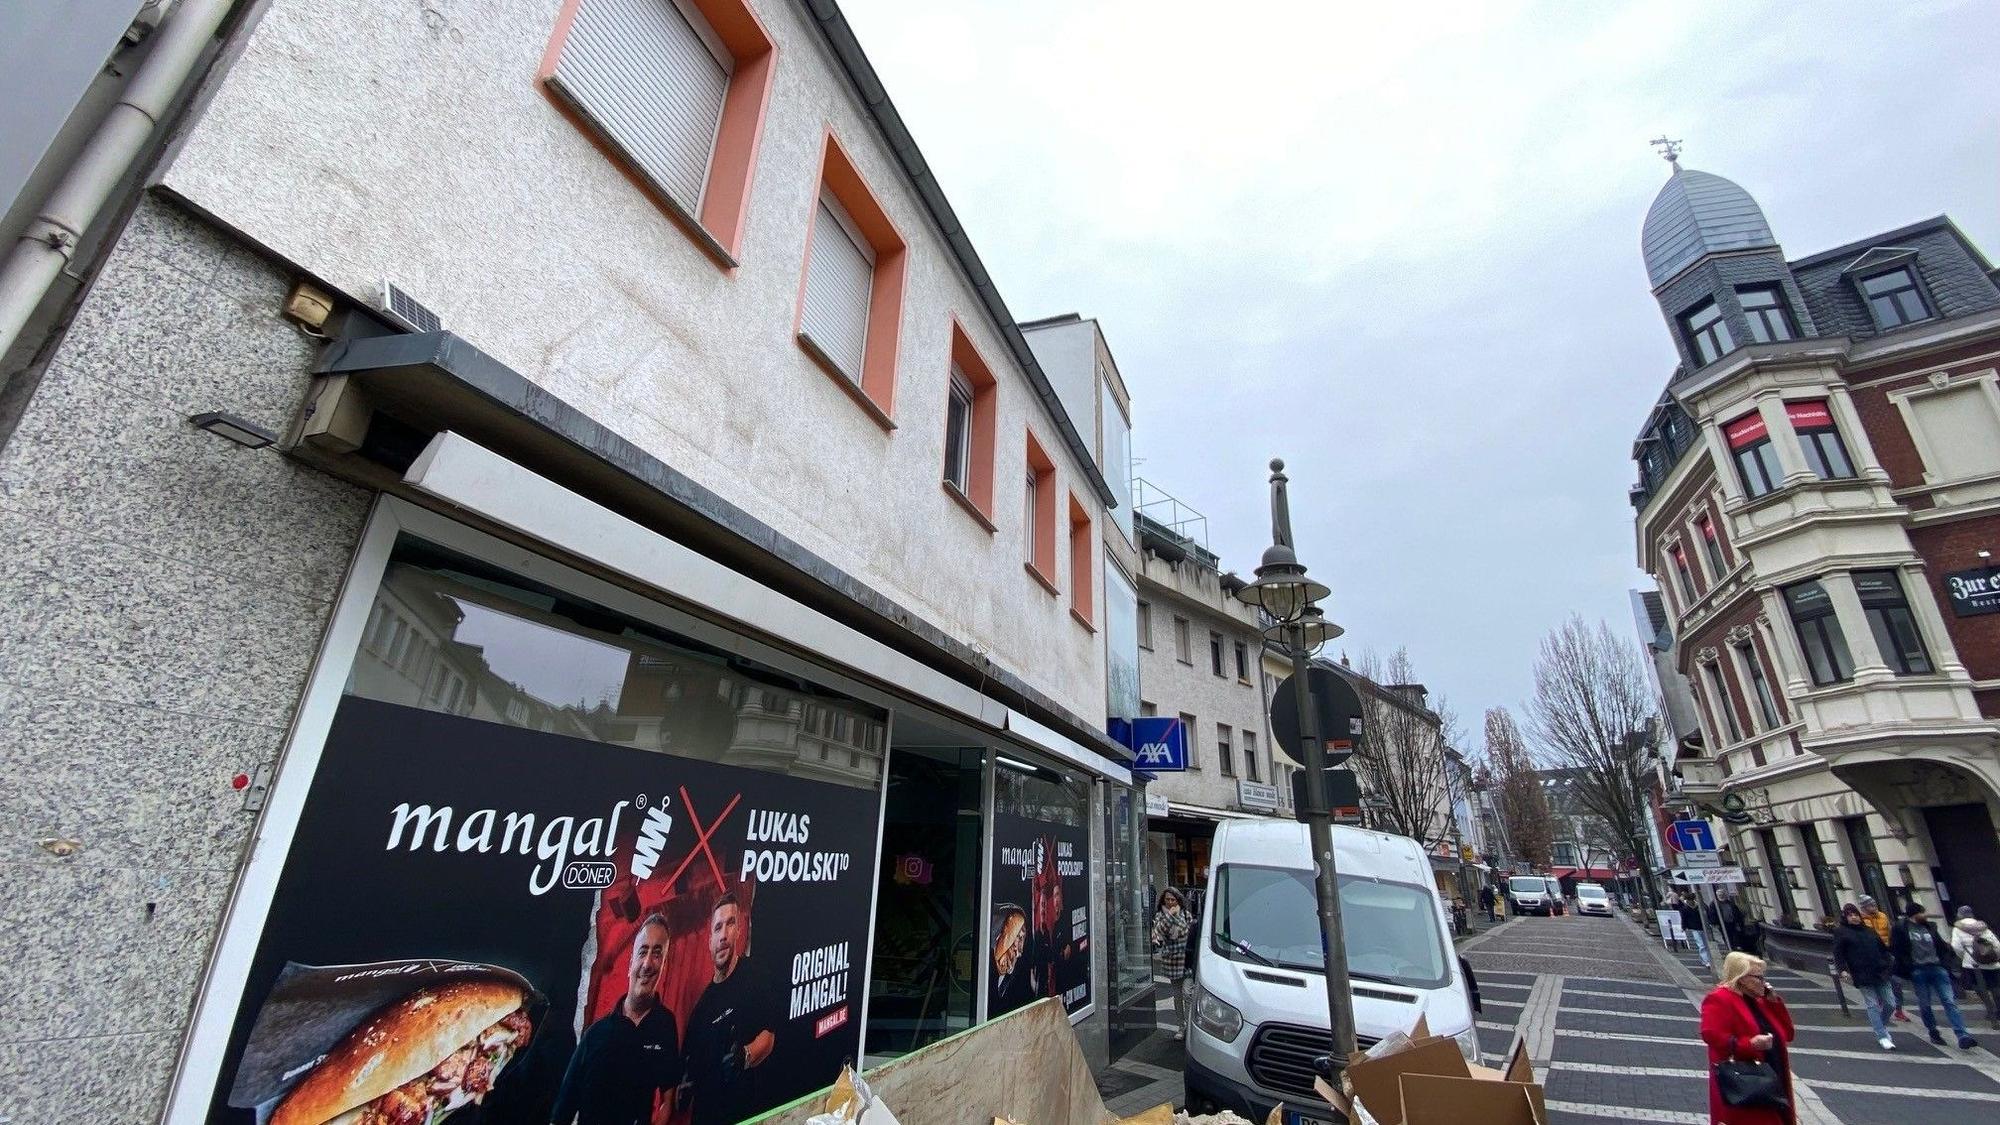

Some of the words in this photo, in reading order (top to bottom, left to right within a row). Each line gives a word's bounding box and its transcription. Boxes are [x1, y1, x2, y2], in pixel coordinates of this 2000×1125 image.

[1950, 577, 1986, 600] Zur
[1134, 742, 1174, 763] AXA
[386, 800, 629, 896] mangal
[746, 809, 811, 844] LUKAS
[1002, 841, 1036, 881] mangal
[567, 863, 612, 885] DÖNER
[791, 941, 850, 985] ORIGINAL
[789, 971, 848, 1020] MANGAL!
